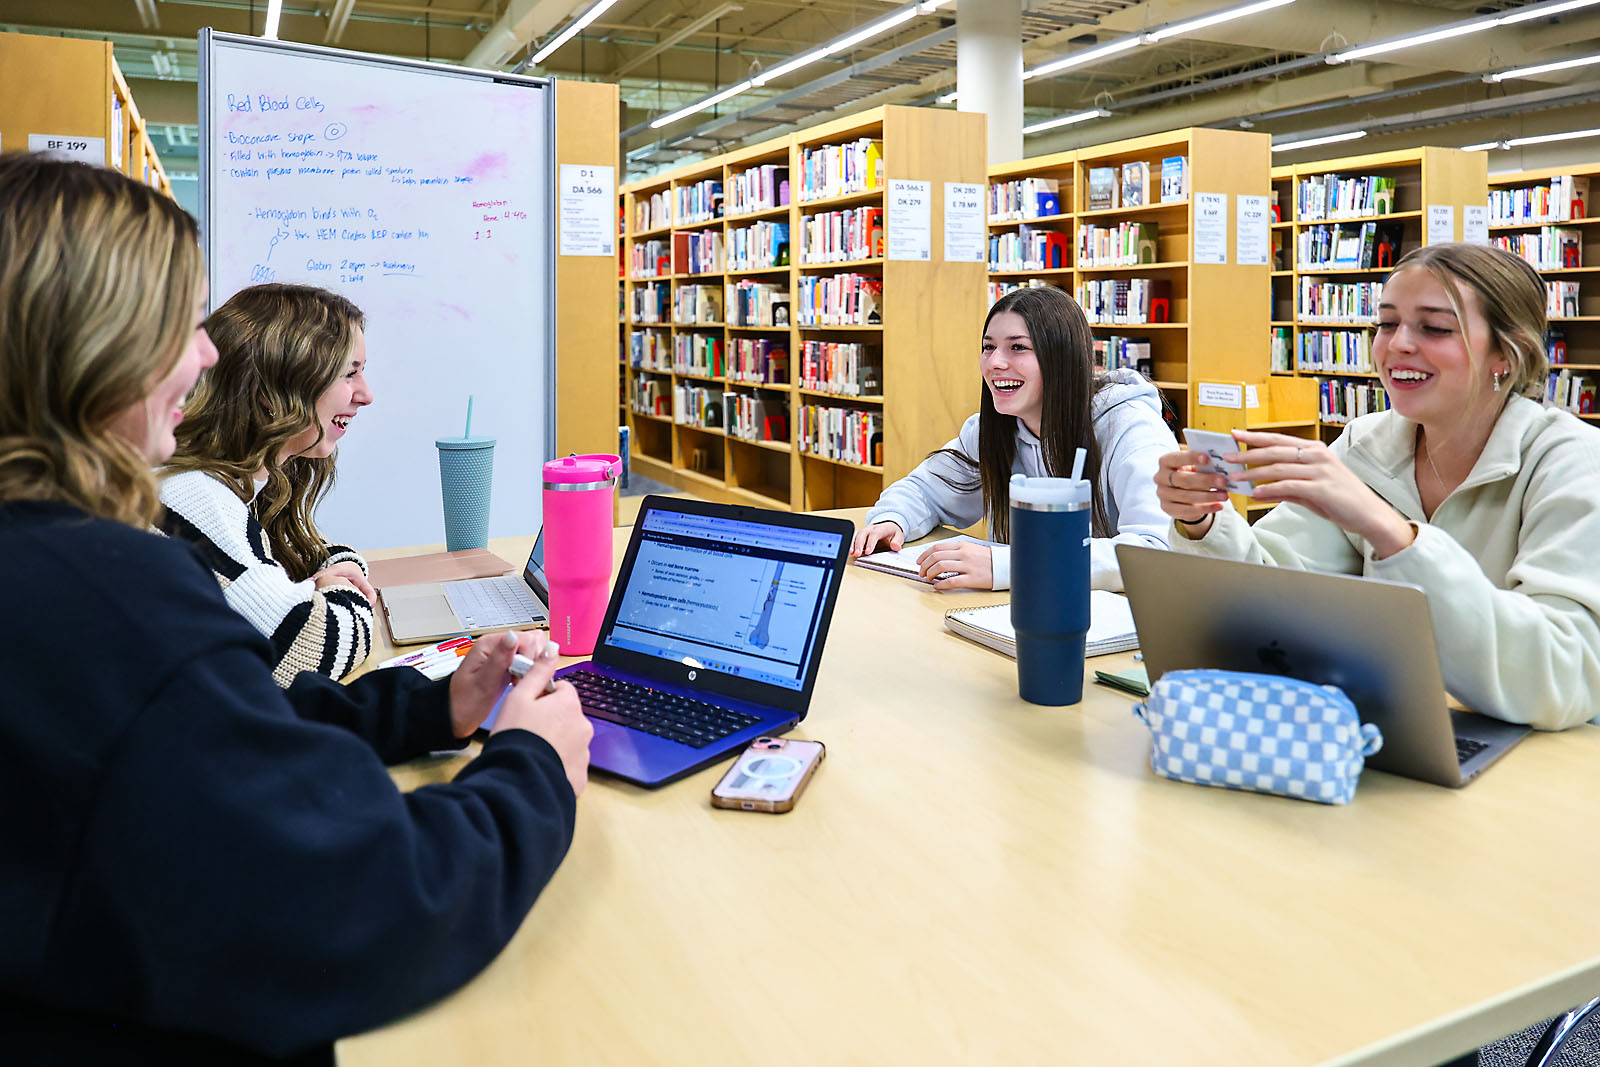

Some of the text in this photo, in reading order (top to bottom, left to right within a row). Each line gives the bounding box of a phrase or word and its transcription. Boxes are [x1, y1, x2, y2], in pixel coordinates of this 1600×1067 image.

[227, 93, 325, 112] Red Blood Cells
[47, 140, 87, 150] BF 199
[587, 187, 602, 195] 566
[255, 207, 307, 228] Hemoglobin
[311, 206, 337, 220] binds
[340, 207, 361, 219] with
